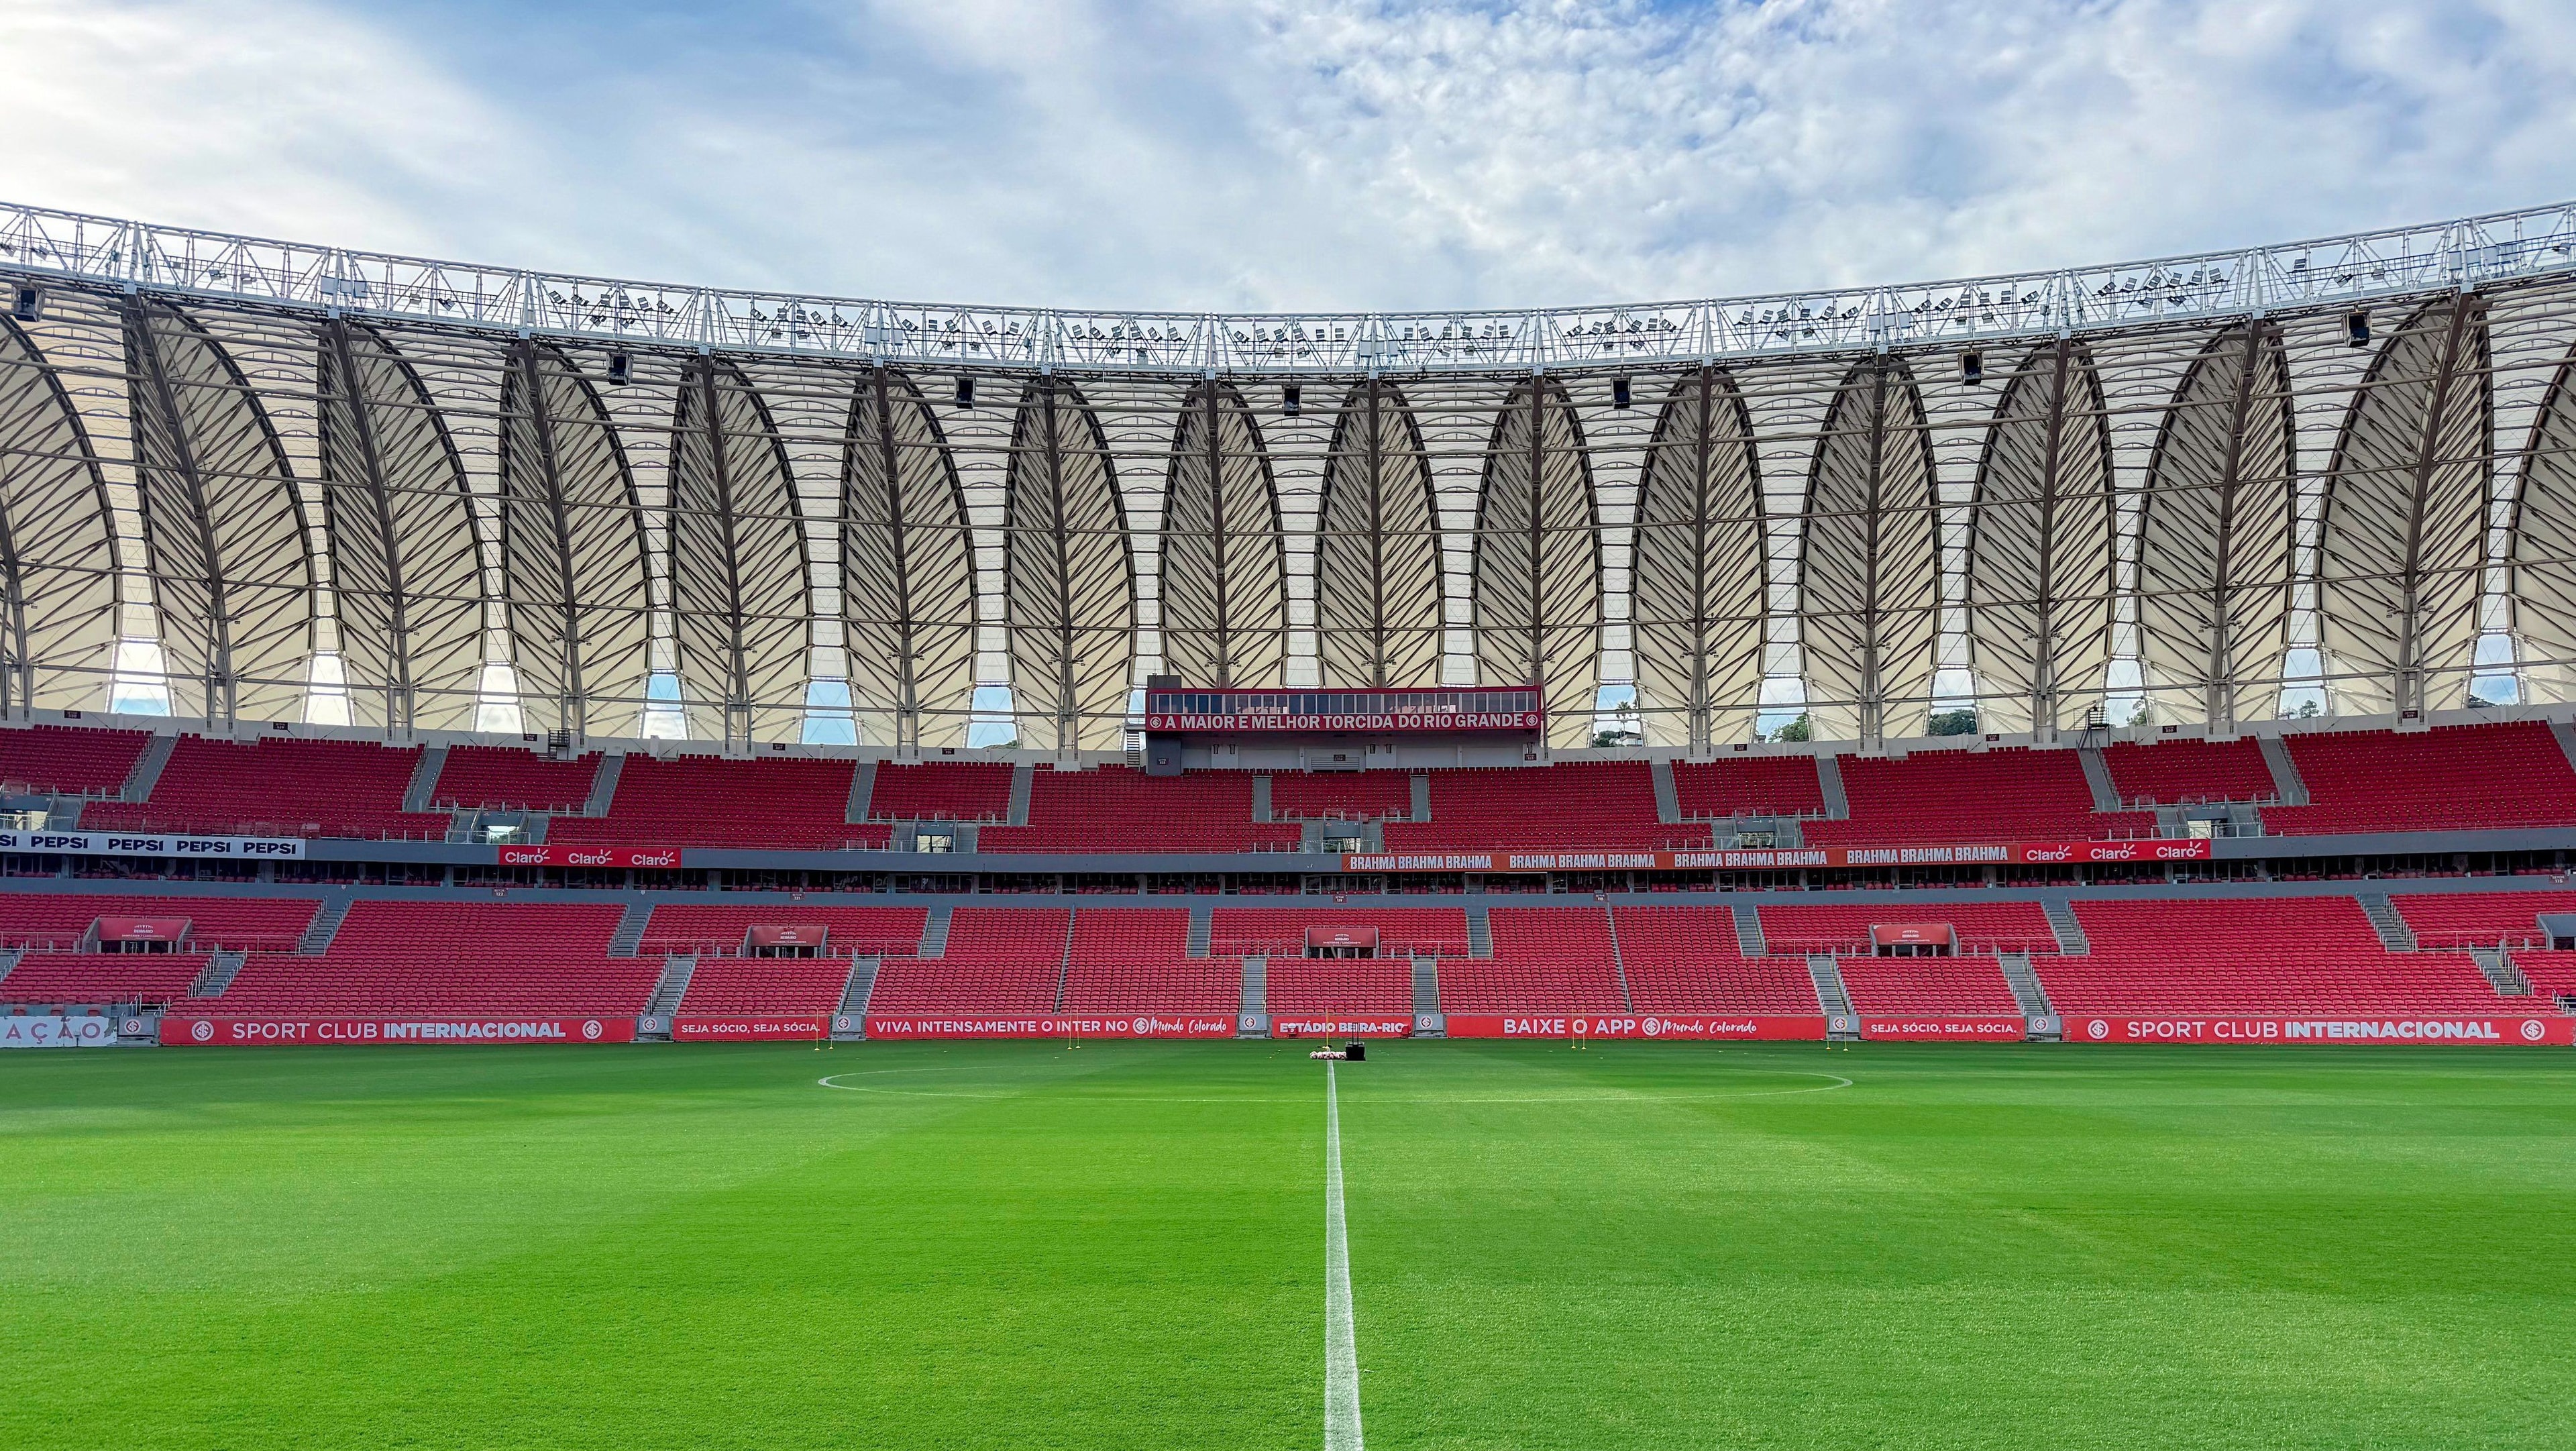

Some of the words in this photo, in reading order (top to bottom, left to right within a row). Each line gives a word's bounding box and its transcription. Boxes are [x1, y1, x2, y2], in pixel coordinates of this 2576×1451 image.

[1165, 716, 1177, 729] A
[1181, 716, 1236, 729] MAIOR
[1239, 716, 1248, 729] E
[1252, 715, 1320, 729] MELHOR
[1323, 715, 1394, 729] TORCIDA
[1399, 715, 1421, 729] DO
[1424, 715, 1452, 728] RIO
[1456, 714, 1523, 728] GRANDE
[31, 836, 88, 849] PEPSI
[108, 839, 164, 851] PEPSI
[176, 841, 231, 853] PEPSI
[244, 842, 296, 854] PEPSI
[2026, 846, 2068, 861] Claro
[2090, 844, 2133, 859] Claro
[2156, 843, 2200, 858] Claro
[505, 849, 546, 863] Claro
[568, 850, 608, 865] Claro
[631, 851, 671, 866] Claro
[1350, 857, 1396, 870] BRAHMA
[1399, 856, 1444, 869] BRAHMA
[1446, 855, 1493, 869] BRAHMA
[1509, 855, 1556, 868] BRAHMA
[1558, 855, 1606, 868] BRAHMA
[1608, 854, 1656, 867] BRAHMA
[1674, 853, 1723, 867] BRAHMA
[1725, 852, 1775, 867] BRAHMA
[1777, 851, 1827, 865] BRAHMA
[1847, 849, 1898, 864] BRAHMA
[1900, 848, 1953, 863] BRAHMA
[1955, 847, 2008, 861] BRAHMA
[6, 1017, 101, 1044] AÇÃO
[232, 1022, 310, 1038] SPORT
[317, 1022, 378, 1038] CLUB
[384, 1022, 566, 1038] INTERNACIONAL
[682, 1024, 709, 1033] SEJA
[712, 1022, 750, 1034] SÓCIO,
[753, 1024, 780, 1032] SEJA
[783, 1022, 820, 1032] SÓCIA.
[875, 1021, 912, 1032] VIVA
[918, 1021, 1036, 1032] INTENSAMENTE
[1041, 1020, 1053, 1032] O
[1057, 1020, 1100, 1032] INTER
[1106, 1020, 1128, 1032] NO
[1150, 1016, 1183, 1034] Mundo
[1188, 1018, 1226, 1034] Colorado
[1504, 1019, 1565, 1034] BAIXE
[1572, 1019, 1588, 1034] O
[1595, 1019, 1635, 1034] APP
[1662, 1019, 1703, 1035] Mundo
[1709, 1020, 1756, 1034] Colorado
[1871, 1024, 1899, 1033] SEJA
[1902, 1022, 1941, 1034] SÓCIO,
[1945, 1024, 1974, 1033] SEJA
[1976, 1022, 2017, 1033] SÓCIA.
[2127, 1021, 2206, 1038] SPORT
[2214, 1021, 2278, 1038] CLUB
[2285, 1021, 2500, 1038] INTERNACIONAL
